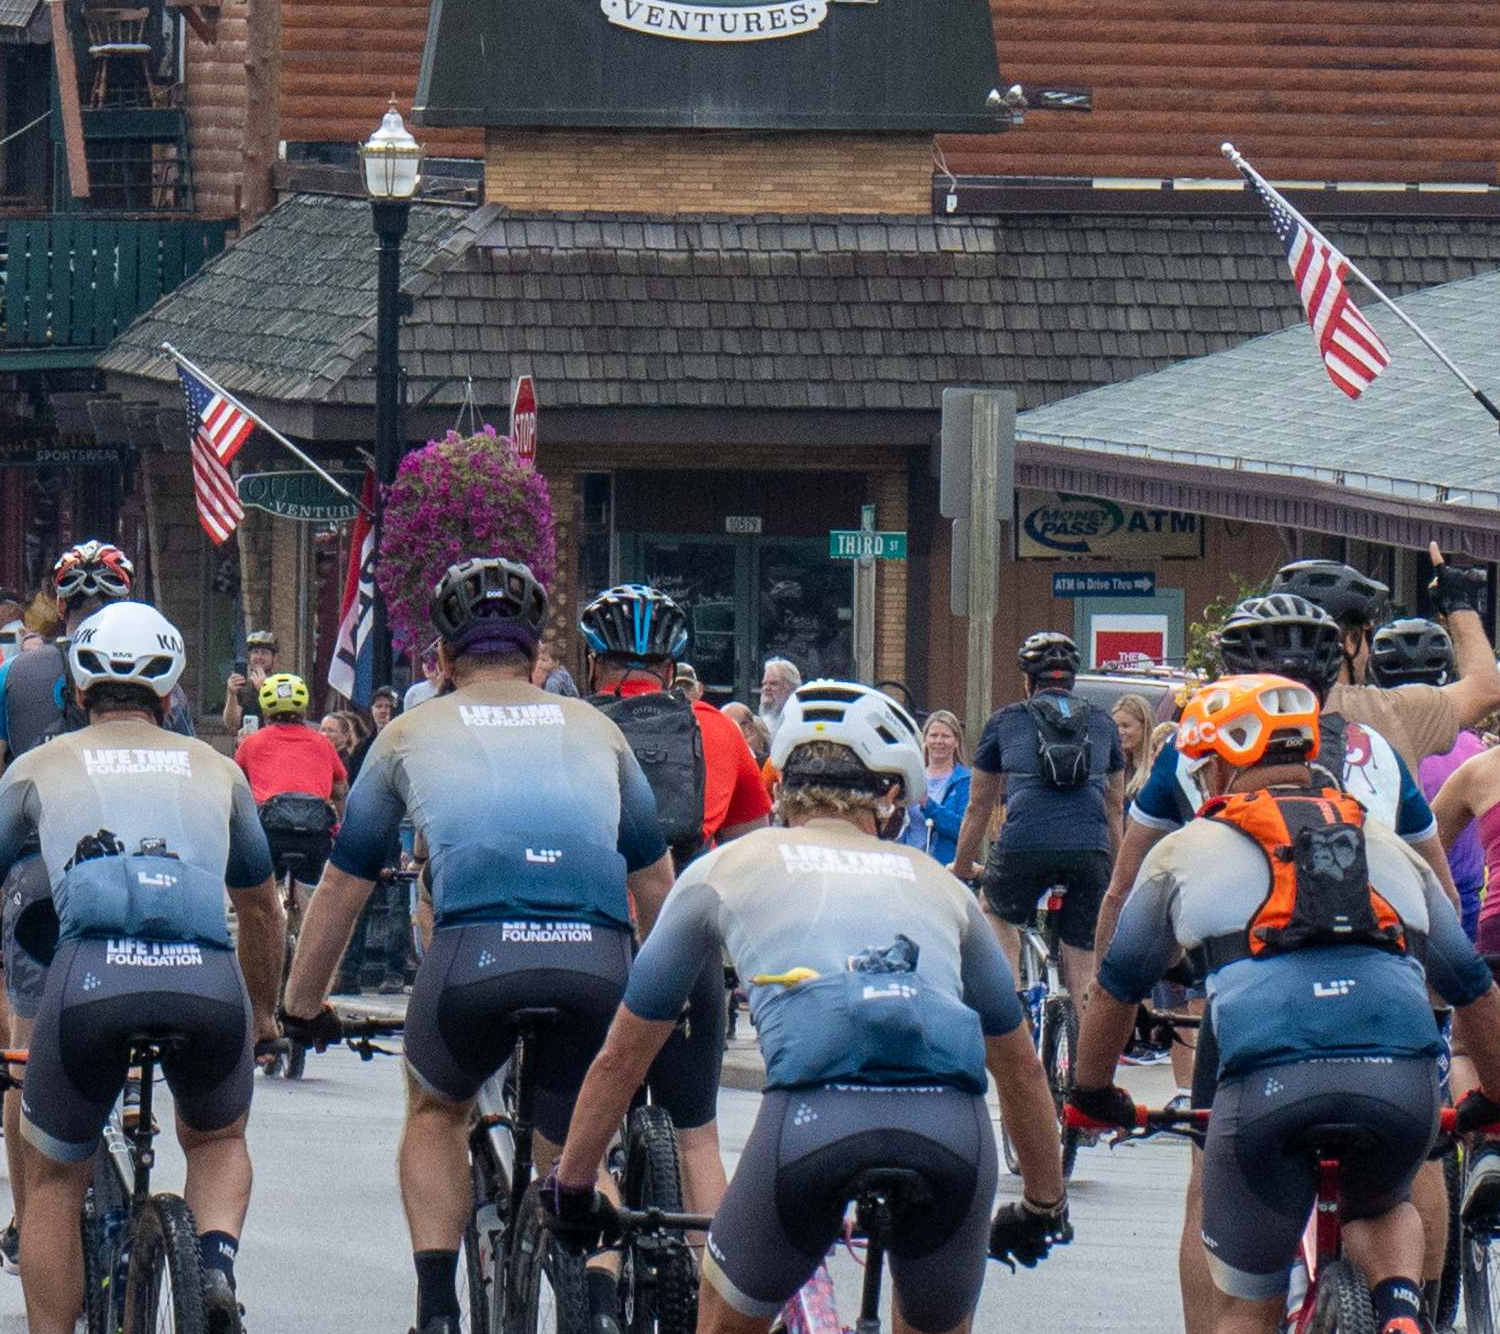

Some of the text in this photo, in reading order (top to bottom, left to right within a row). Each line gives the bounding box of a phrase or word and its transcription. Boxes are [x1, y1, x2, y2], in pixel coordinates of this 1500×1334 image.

[513, 411, 537, 453] STOP
[37, 448, 120, 463] SPORTSWEAR
[1039, 508, 1110, 523] MONEY
[1127, 510, 1197, 534] ATM
[728, 517, 760, 533] 10579
[1039, 521, 1099, 537] PASS
[837, 534, 884, 556] THIRD
[1054, 577, 1133, 591] ATM in Drive Thru
[457, 703, 566, 720] LIFE TIME
[462, 715, 567, 728] FOUNDATION
[83, 748, 191, 768] LIFE TIME
[86, 763, 193, 778] FOUNDATION
[778, 842, 913, 871] LIFE TIME
[784, 859, 917, 884] FOUNDATION
[501, 928, 593, 944] FOUNDATION
[106, 939, 149, 956] LIFE
[106, 953, 203, 967] FOUNDATION
